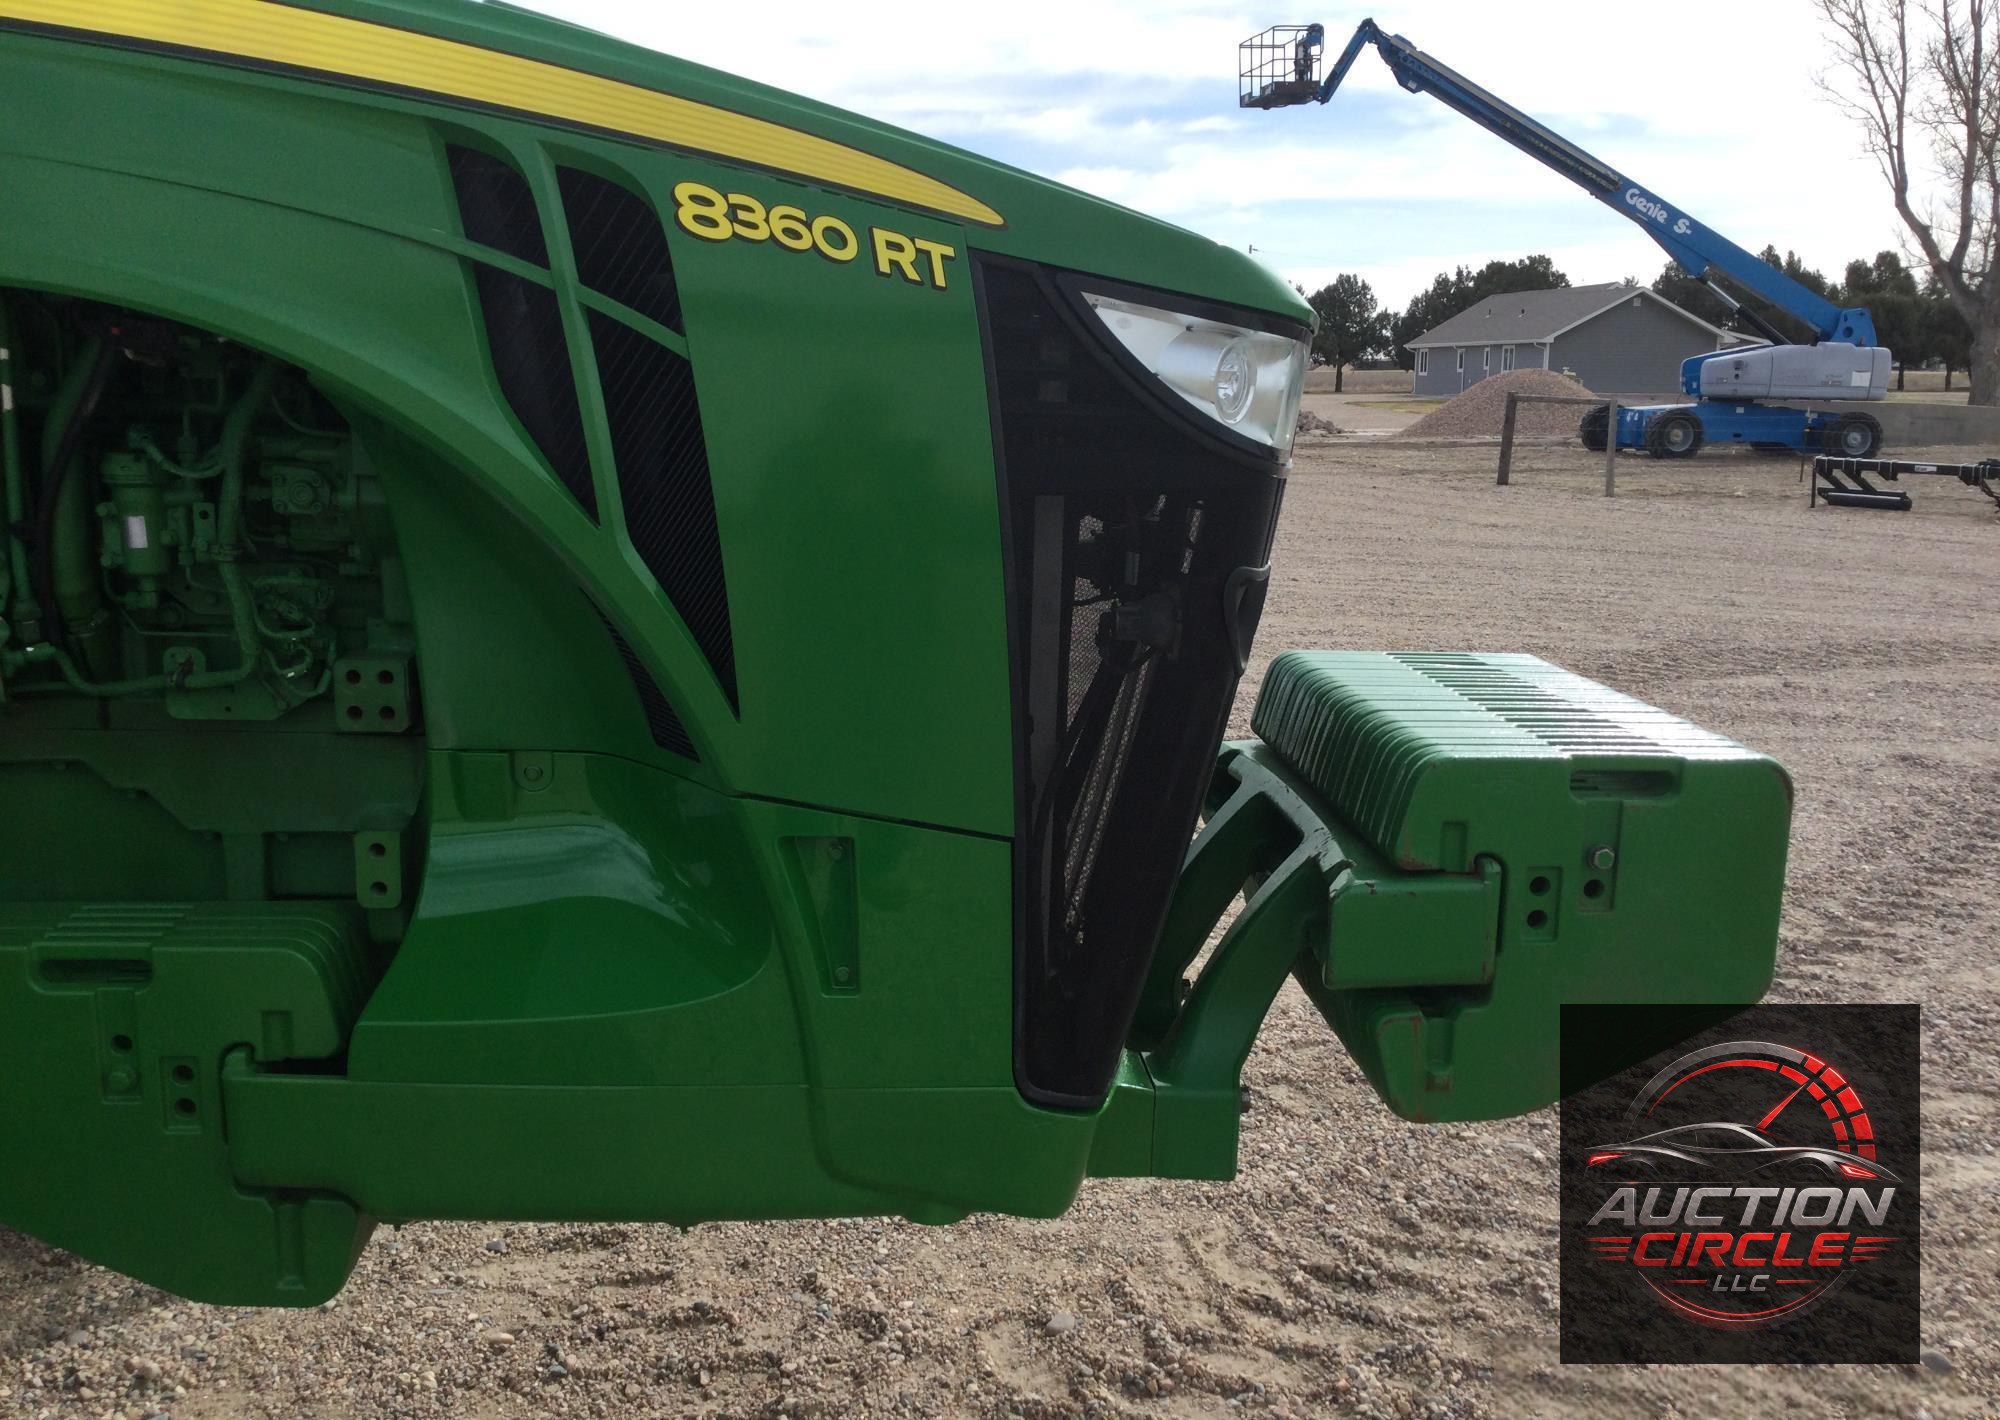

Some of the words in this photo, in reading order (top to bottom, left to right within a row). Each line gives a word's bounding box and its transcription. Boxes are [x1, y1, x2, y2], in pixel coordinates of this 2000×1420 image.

[671, 181, 858, 264] 8360
[869, 226, 955, 292] RT
[1625, 188, 1667, 224] Genie
